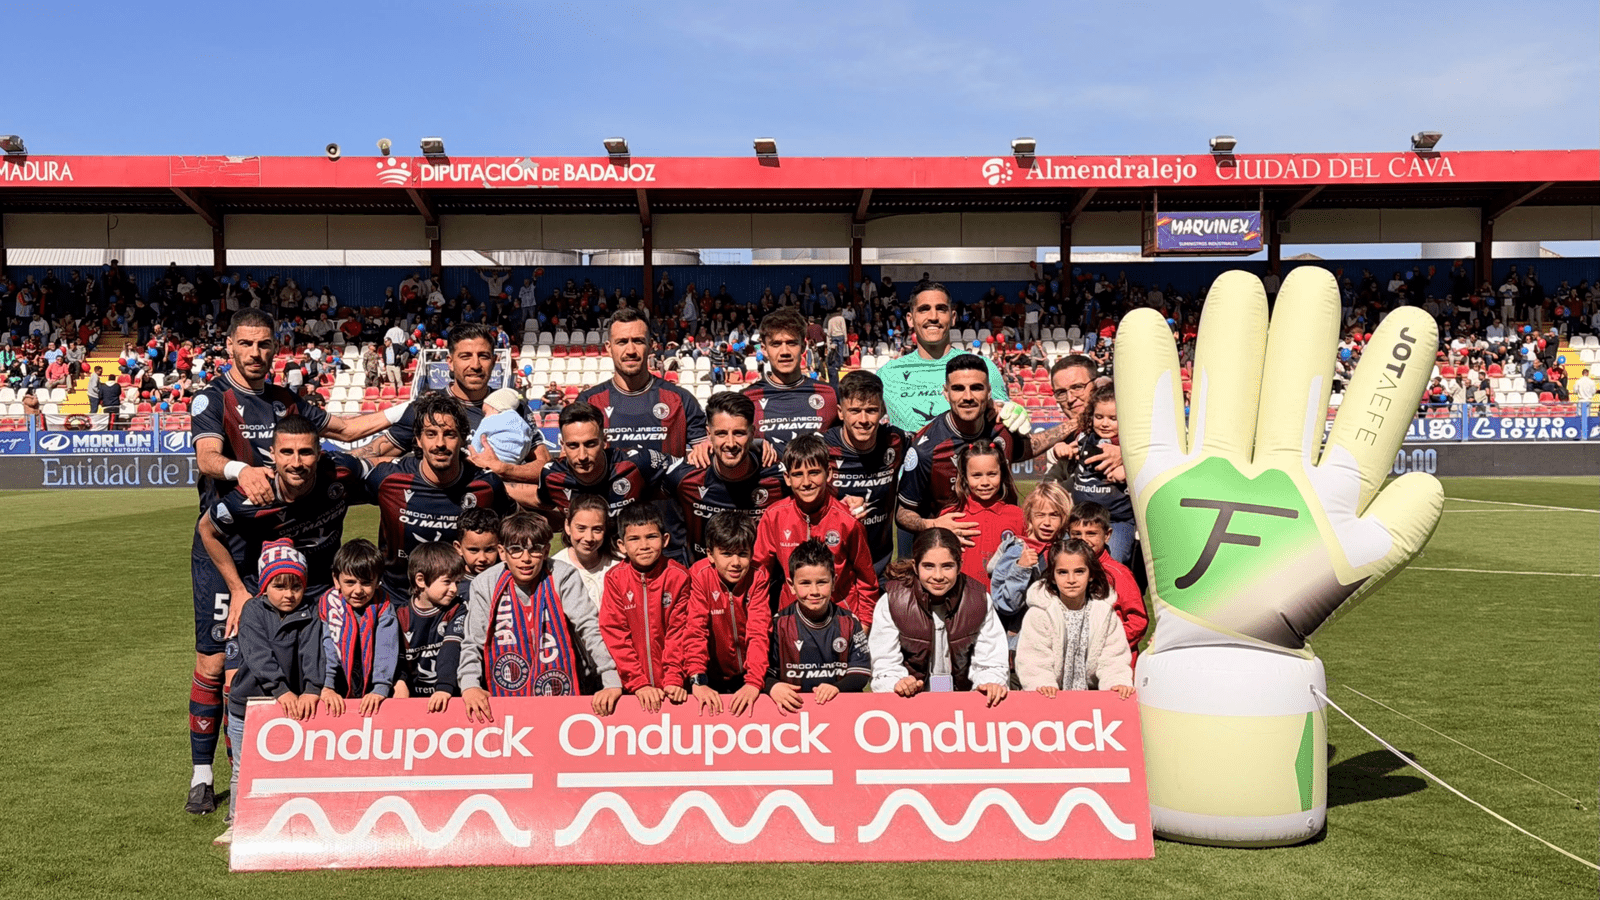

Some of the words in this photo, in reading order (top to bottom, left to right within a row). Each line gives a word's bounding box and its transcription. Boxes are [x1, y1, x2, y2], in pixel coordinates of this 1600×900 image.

[421, 158, 538, 182] DIPUTACIÓN
[564, 164, 656, 182] BADAJOZ
[1026, 158, 1197, 184] Almendralejo
[1215, 158, 1321, 180] CIUDAD
[1328, 158, 1380, 178] DEL
[1389, 156, 1455, 178] CAVA
[1171, 218, 1249, 236] MAQUINEX
[759, 424, 775, 432] OJ
[777, 422, 822, 430] MAVEN
[1501, 417, 1565, 428] GRUPO
[72, 431, 151, 447] MORLÓN
[622, 433, 668, 441] MAVEN
[1501, 427, 1578, 438] LOZANO
[1388, 448, 1437, 474] 0:00
[42, 457, 140, 485] Entidad
[147, 457, 179, 485] de
[853, 475, 893, 488] MAVEN
[399, 508, 432, 520] OMODA
[399, 515, 419, 525] OJ
[213, 592, 230, 621] 5
[786, 670, 805, 678] OJ
[256, 715, 534, 770] Ondupack
[558, 711, 832, 766] Ondupack
[854, 708, 1127, 763] Ondupack
